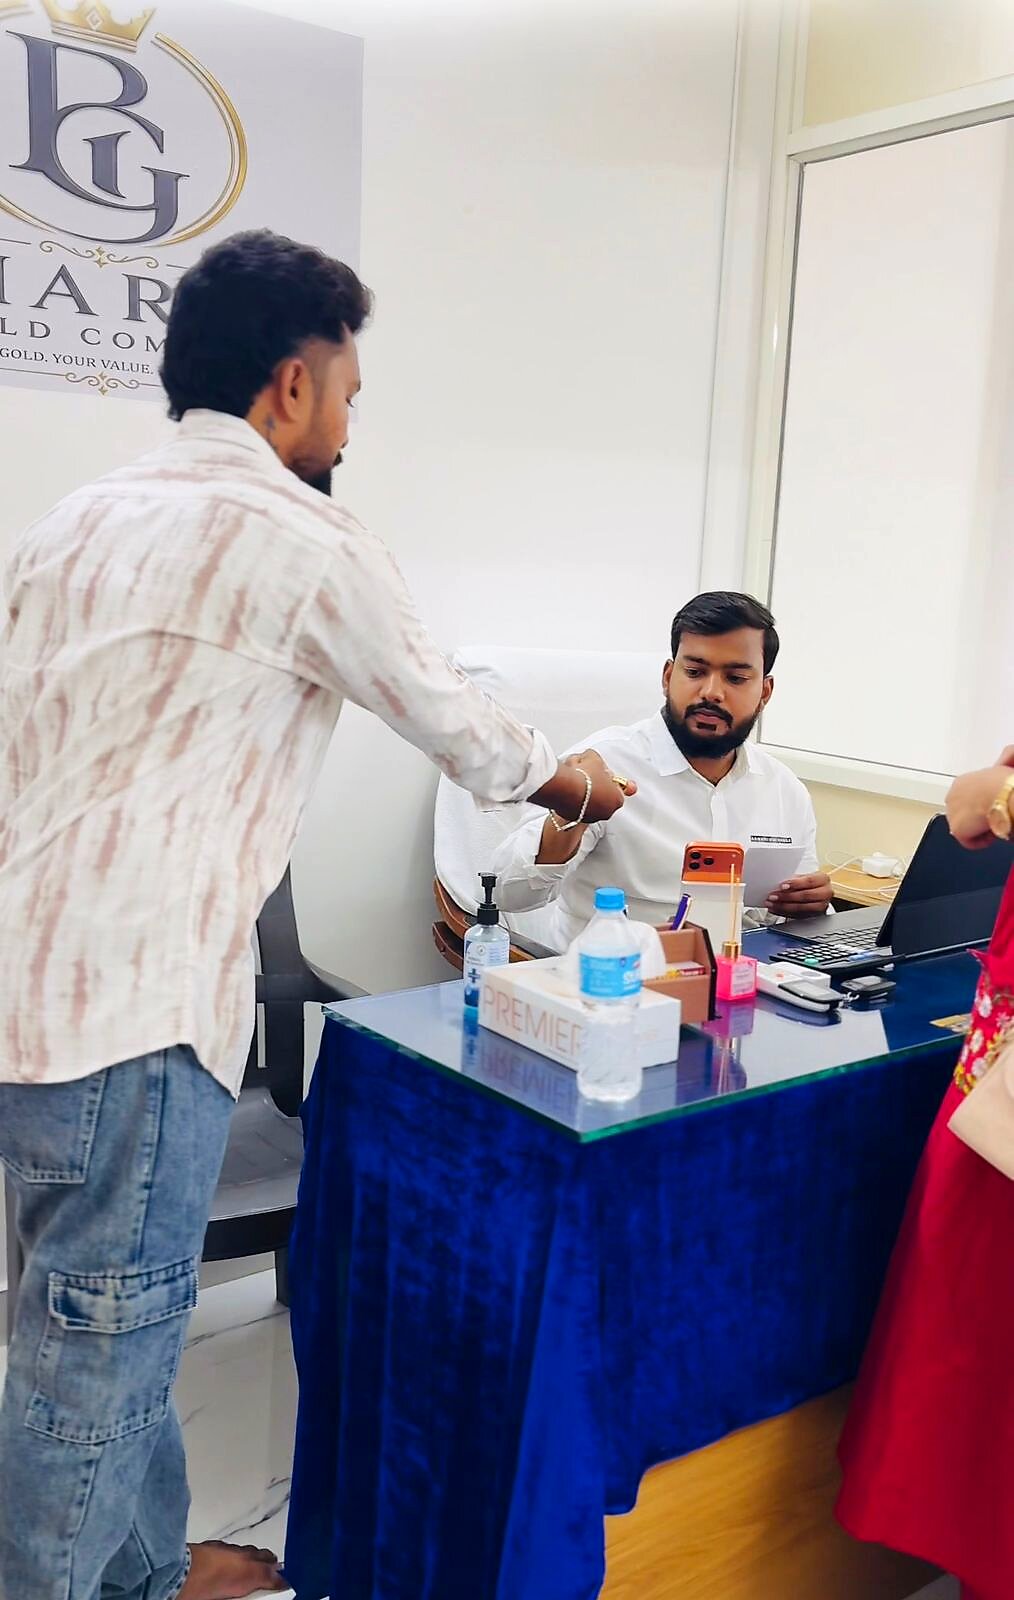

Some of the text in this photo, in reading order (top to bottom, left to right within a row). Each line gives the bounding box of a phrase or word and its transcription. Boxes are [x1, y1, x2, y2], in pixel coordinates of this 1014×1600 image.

[0, 347, 154, 375] GOLD. YOUR VALUE.
